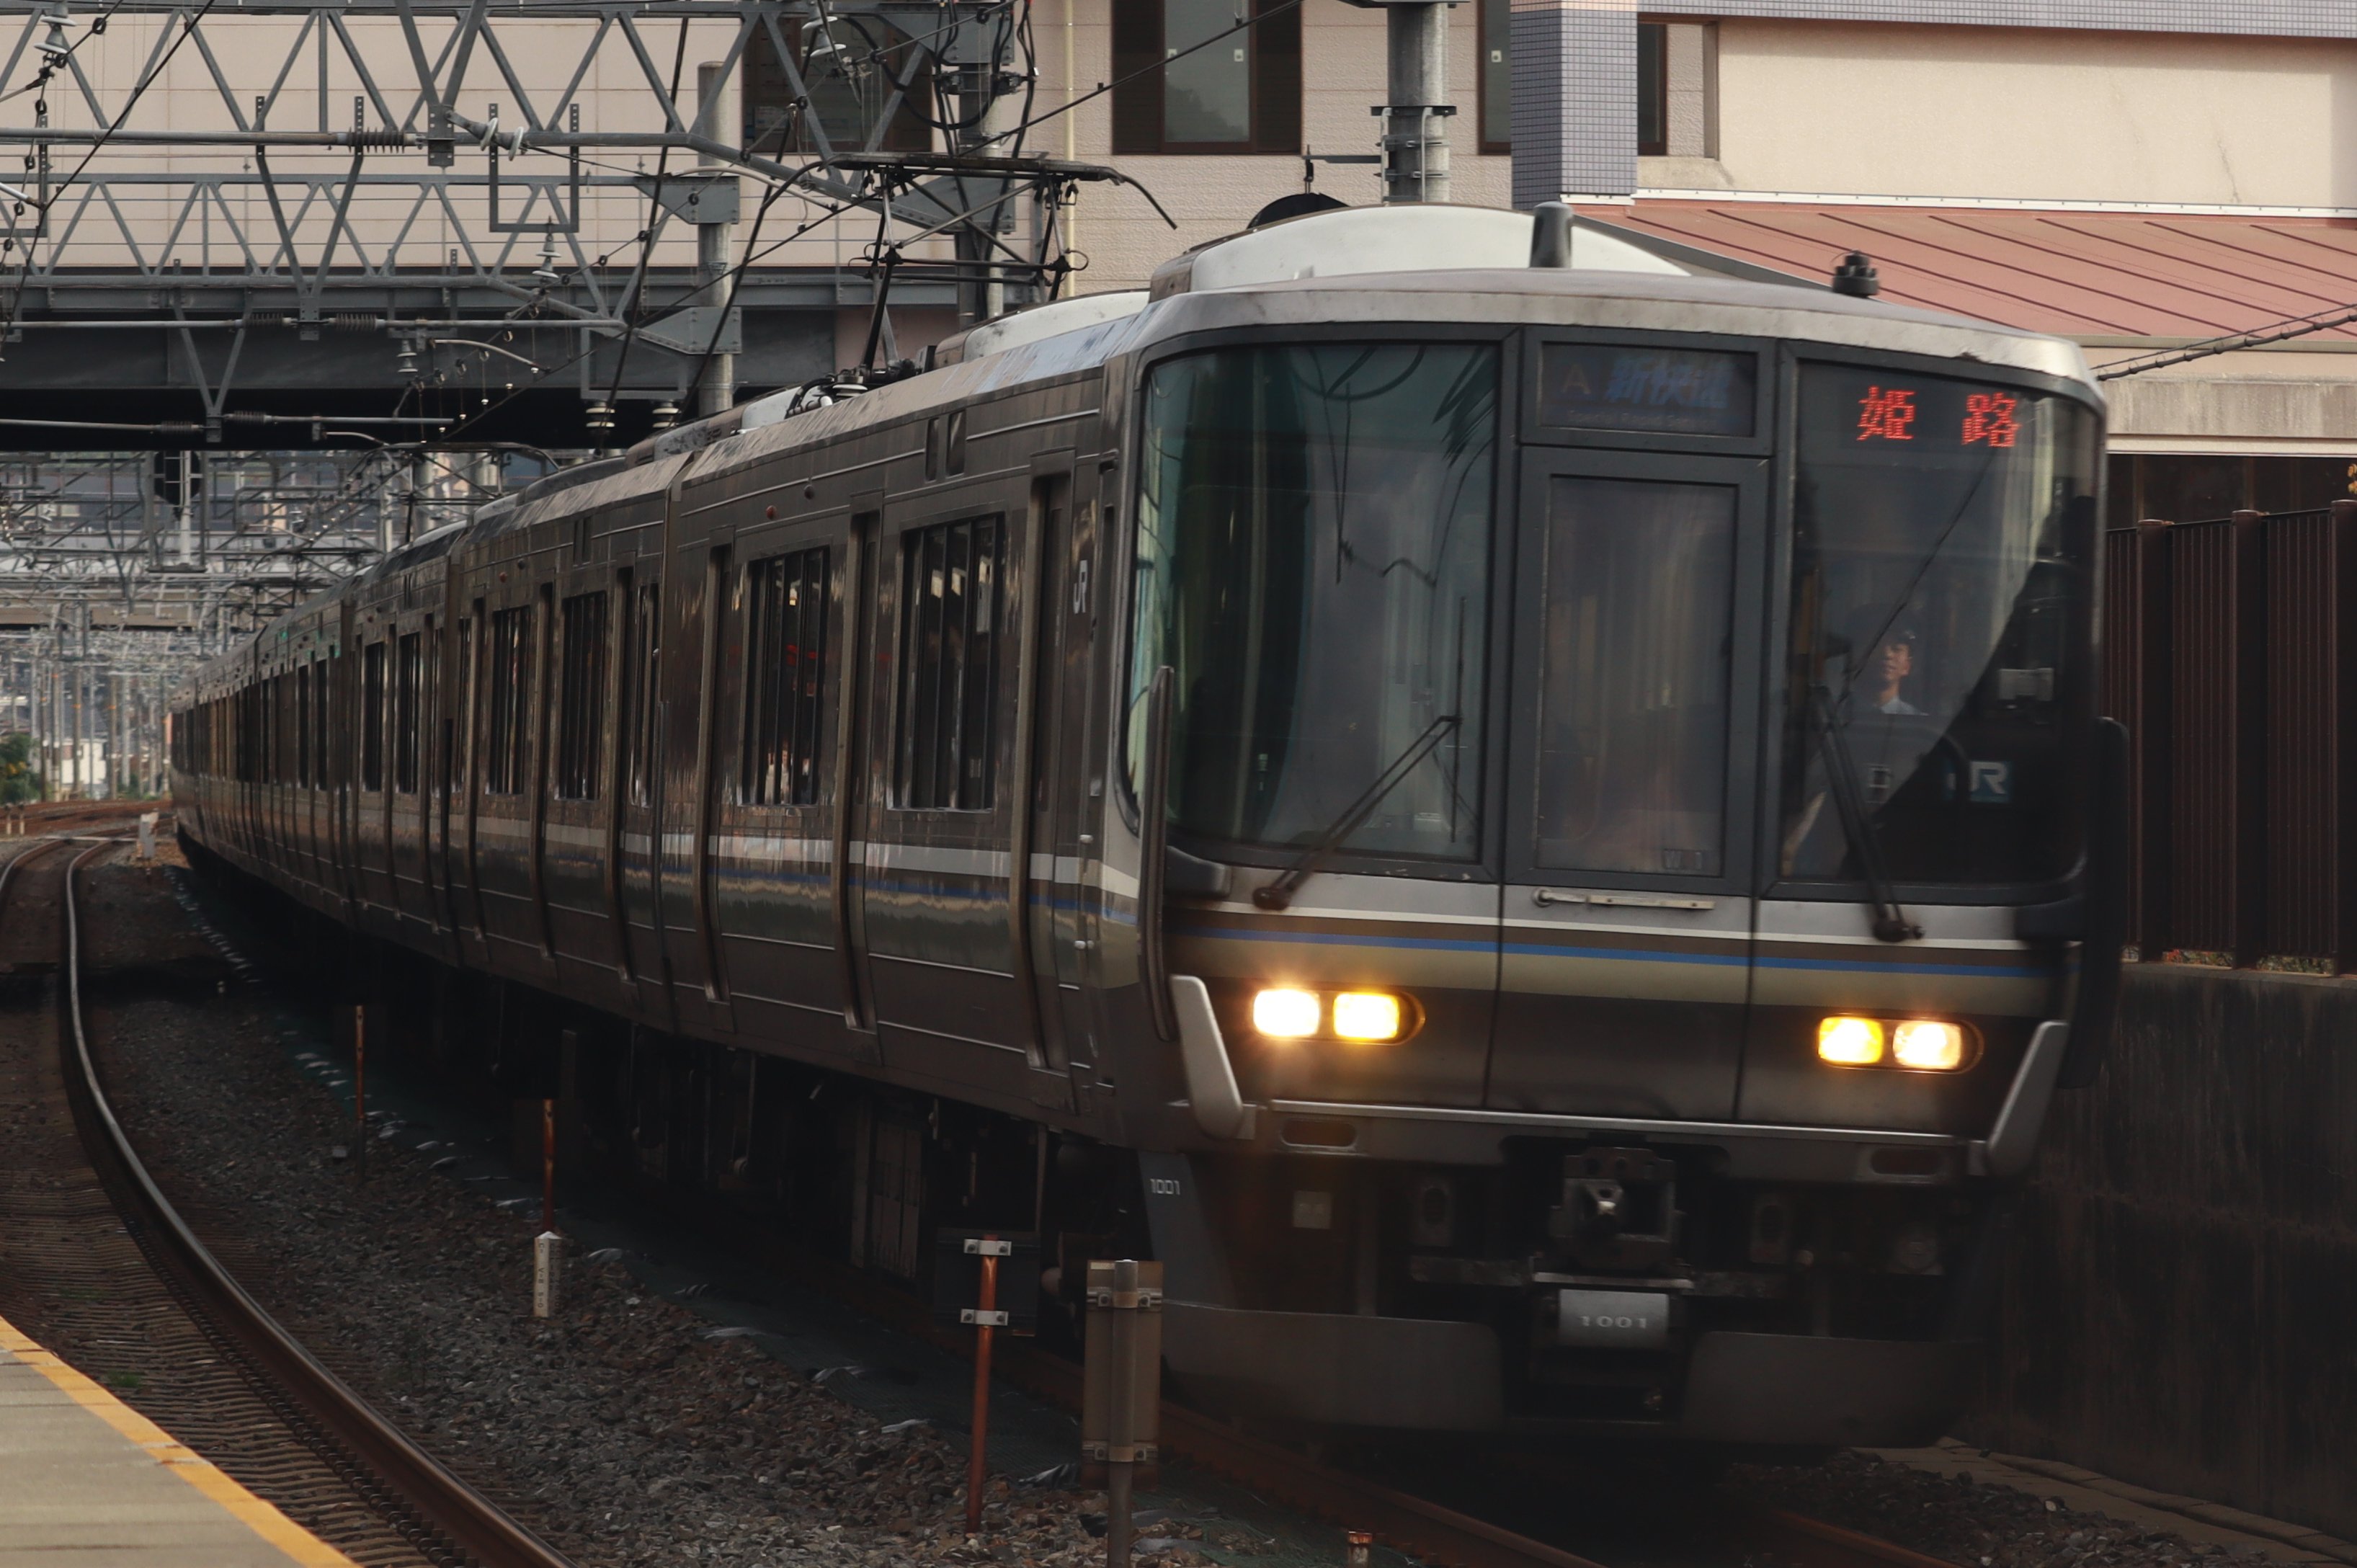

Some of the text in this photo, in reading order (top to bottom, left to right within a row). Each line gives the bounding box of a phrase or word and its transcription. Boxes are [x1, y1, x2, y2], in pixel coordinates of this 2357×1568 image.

[1561, 363, 1591, 395] A
[1074, 560, 1088, 614] JR
[1150, 1178, 1181, 1195] 1001
[1579, 1315, 1647, 1329] 1001
